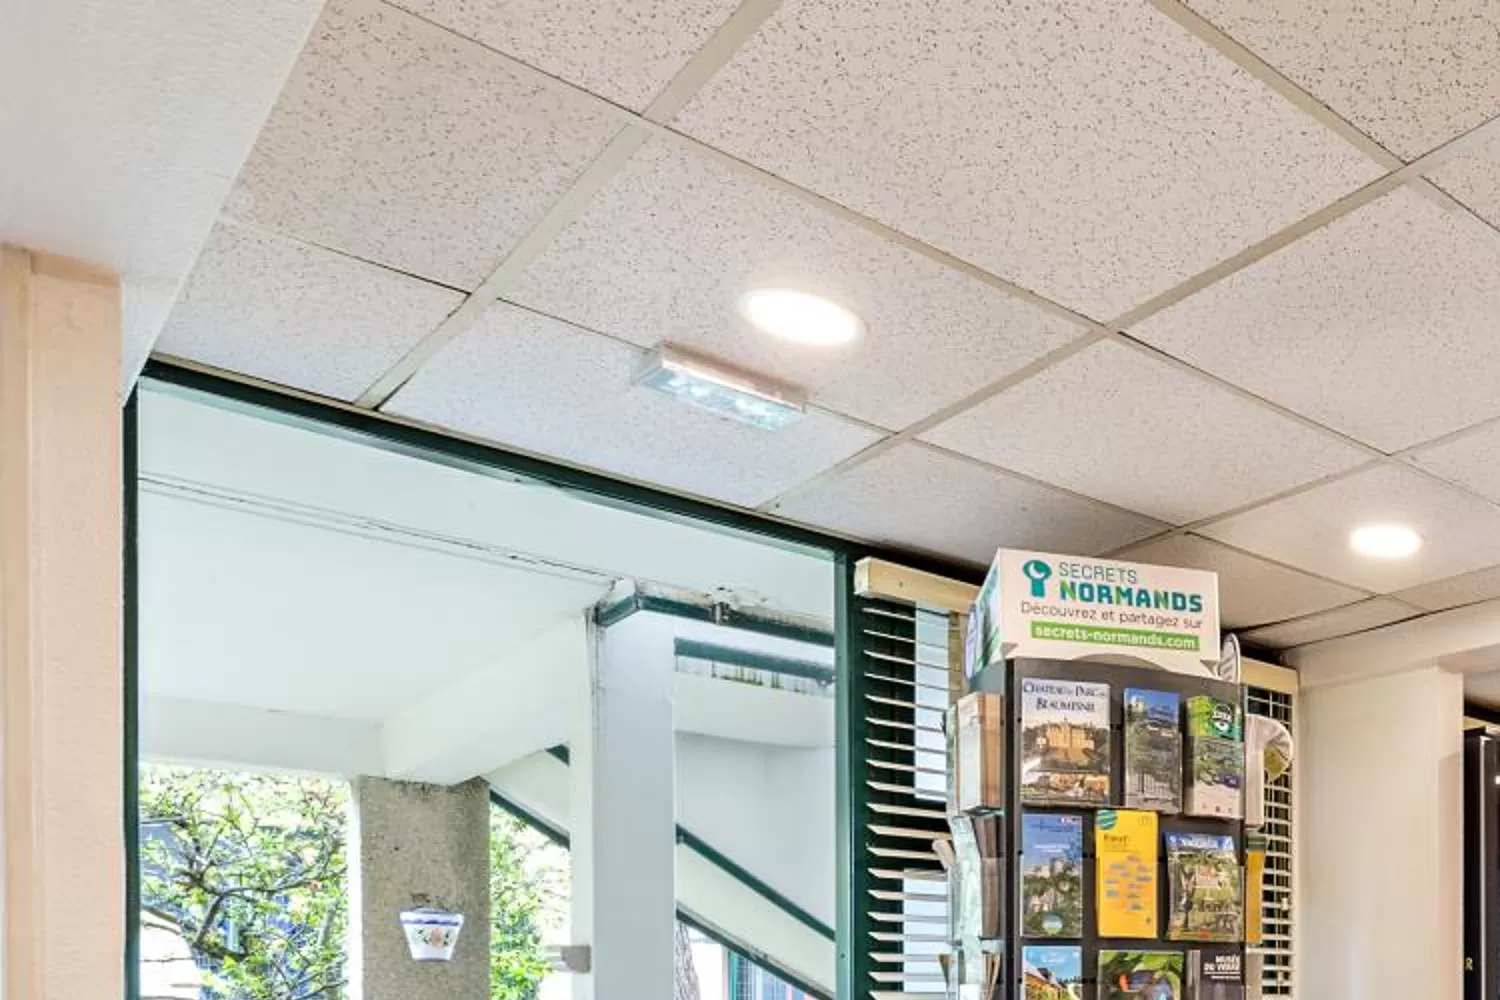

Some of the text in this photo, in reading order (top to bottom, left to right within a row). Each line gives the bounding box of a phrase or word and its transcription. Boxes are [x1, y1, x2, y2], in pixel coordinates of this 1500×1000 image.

[1059, 562, 1137, 584] SECRETS
[1060, 580, 1203, 613] NORMANDS
[1021, 601, 1203, 629] Découvrez et partagez sur
[1035, 625, 1196, 648] secrets-normands.com
